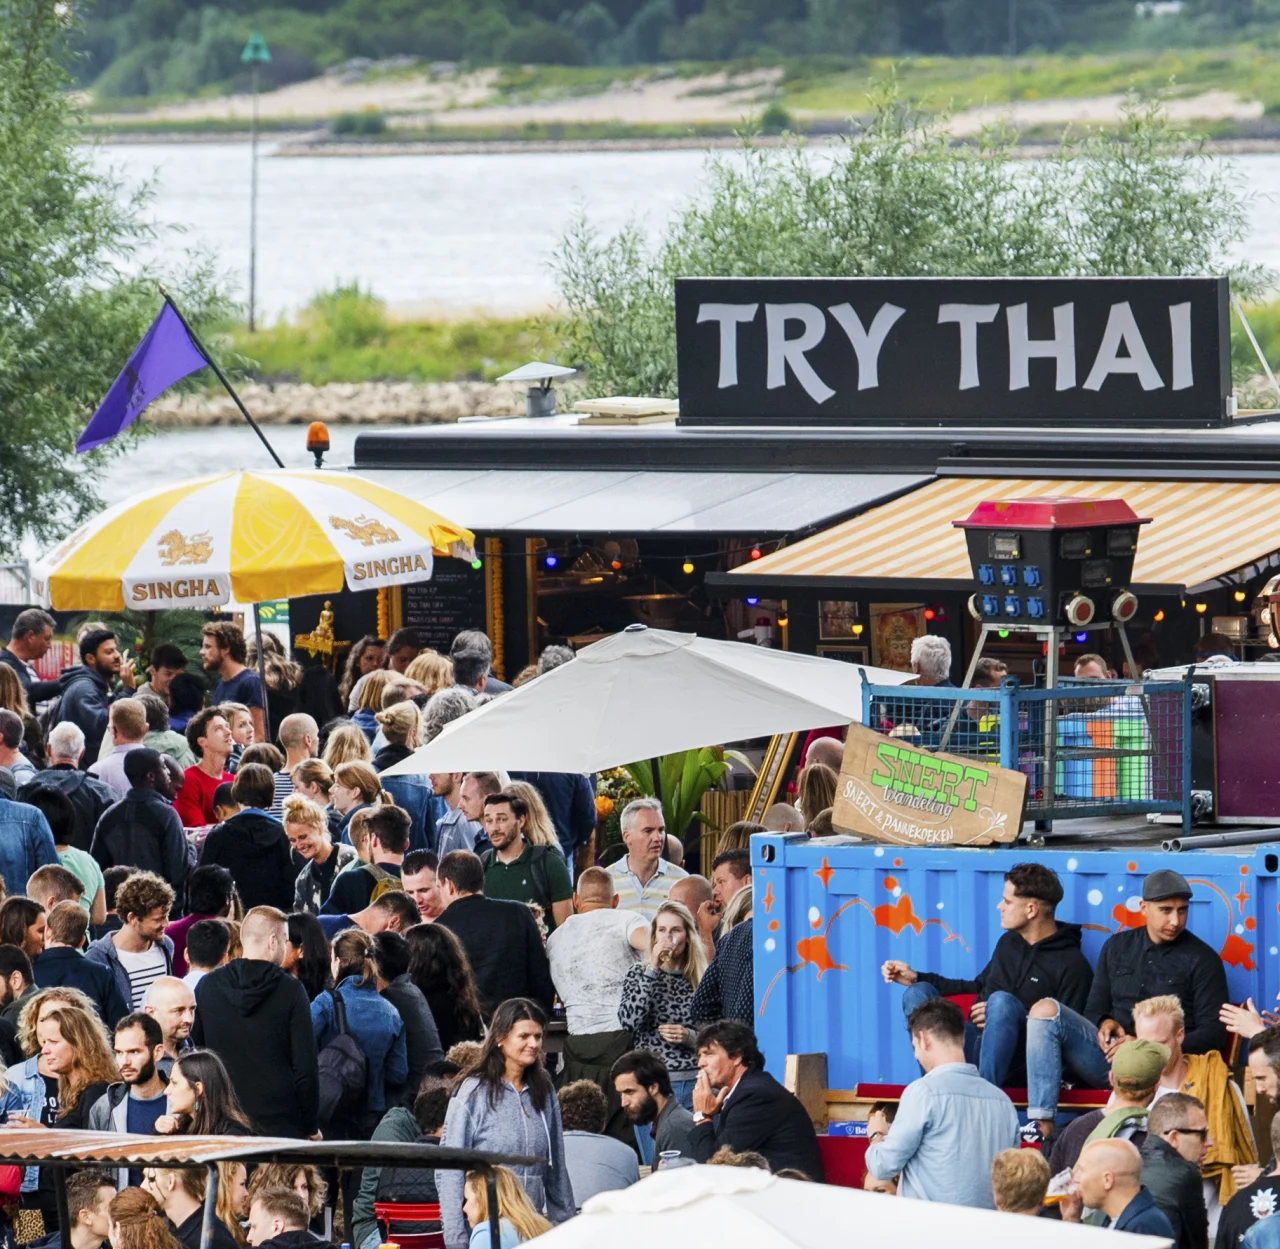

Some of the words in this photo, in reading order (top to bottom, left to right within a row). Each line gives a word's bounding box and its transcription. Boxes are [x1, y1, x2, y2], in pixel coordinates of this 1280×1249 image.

[696, 302, 906, 404] TRY
[937, 301, 1194, 391] THAI
[132, 578, 221, 602] SINGHA
[352, 553, 428, 580] SINGHA
[871, 742, 989, 812] SNERT
[882, 784, 953, 817] Wandeling
[843, 780, 877, 816] SNERT
[874, 810, 884, 822] &
[882, 814, 954, 843] PANNEKOEKEN
